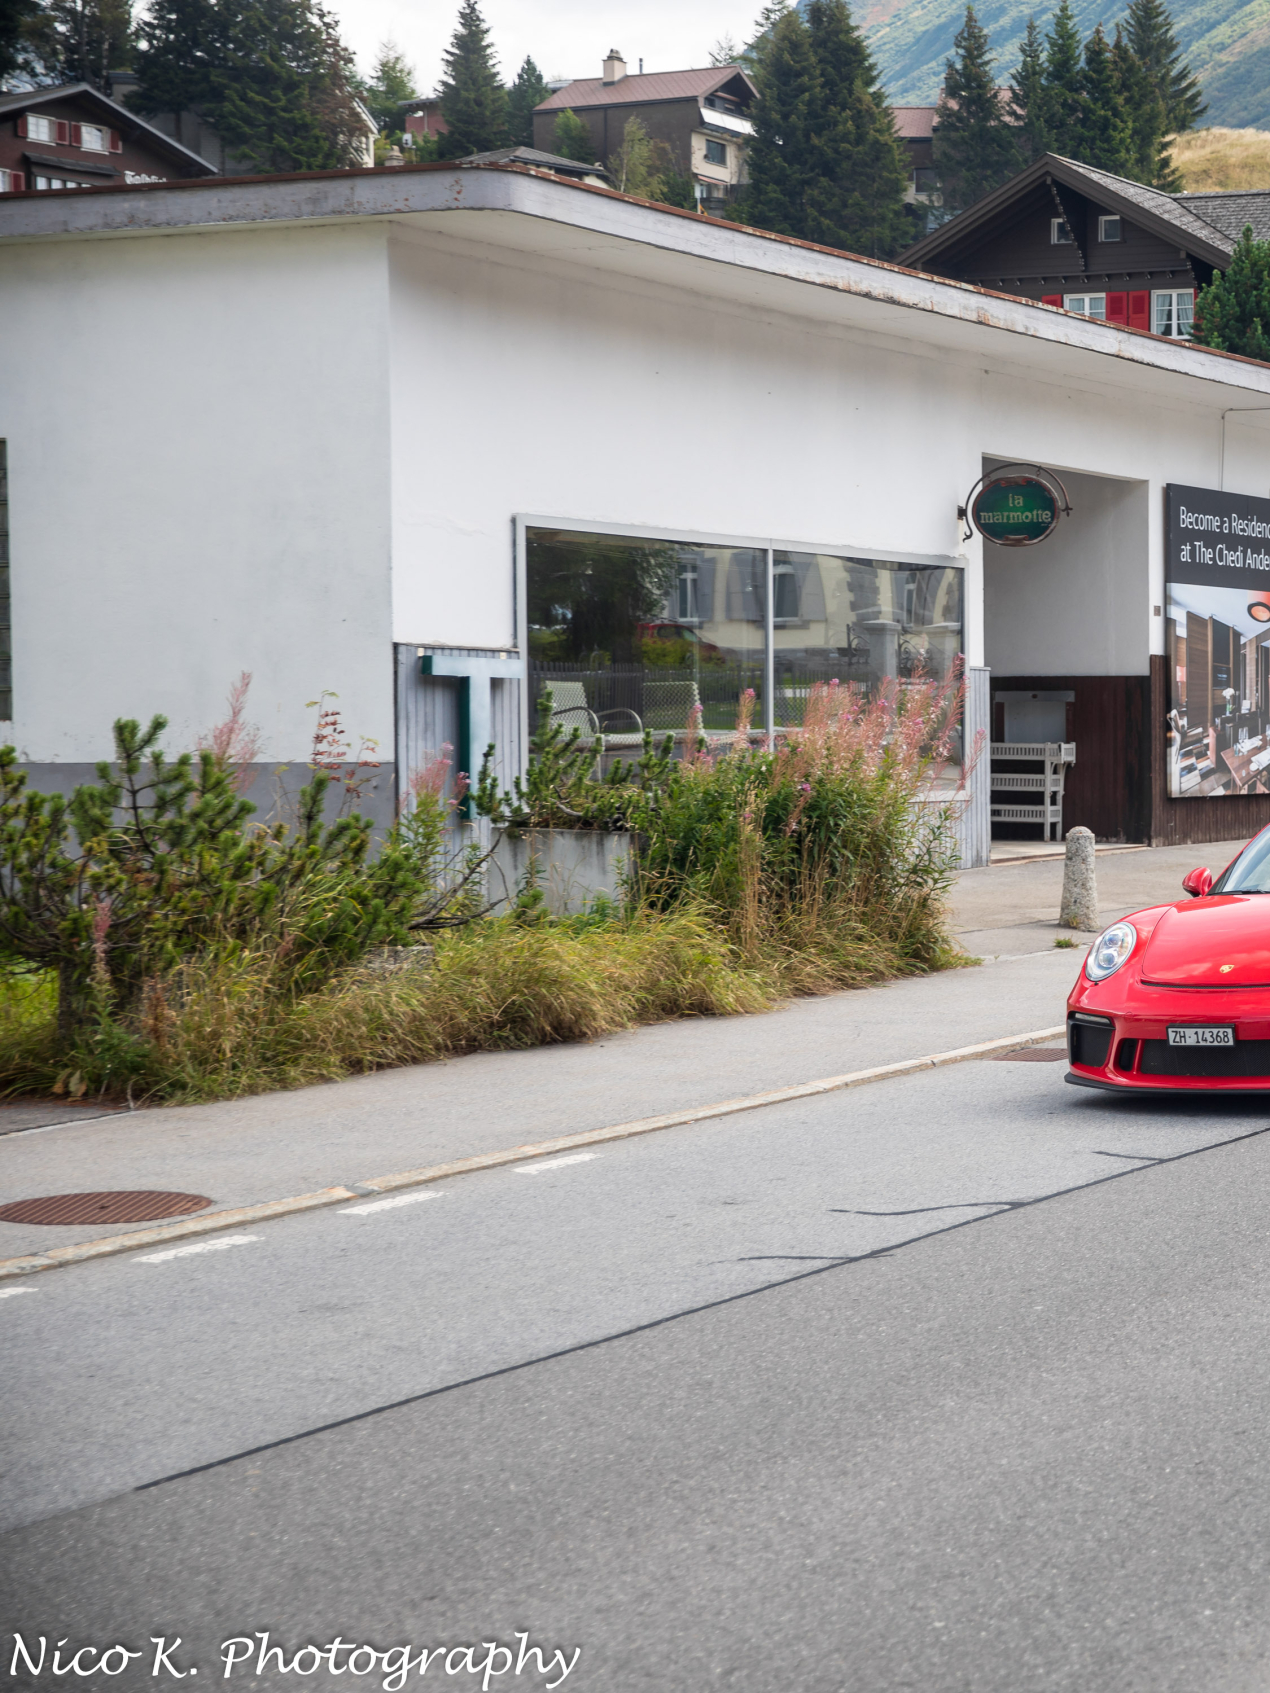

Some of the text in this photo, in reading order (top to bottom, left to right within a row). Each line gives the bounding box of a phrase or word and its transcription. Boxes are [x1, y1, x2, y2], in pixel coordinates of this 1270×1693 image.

[1009, 494, 1023, 507] la
[980, 509, 1052, 524] marmotte
[1180, 506, 1220, 532] Become
[1223, 517, 1229, 533] a
[1180, 542, 1191, 562] at
[1194, 540, 1214, 565] The
[1215, 543, 1244, 568] Chedi
